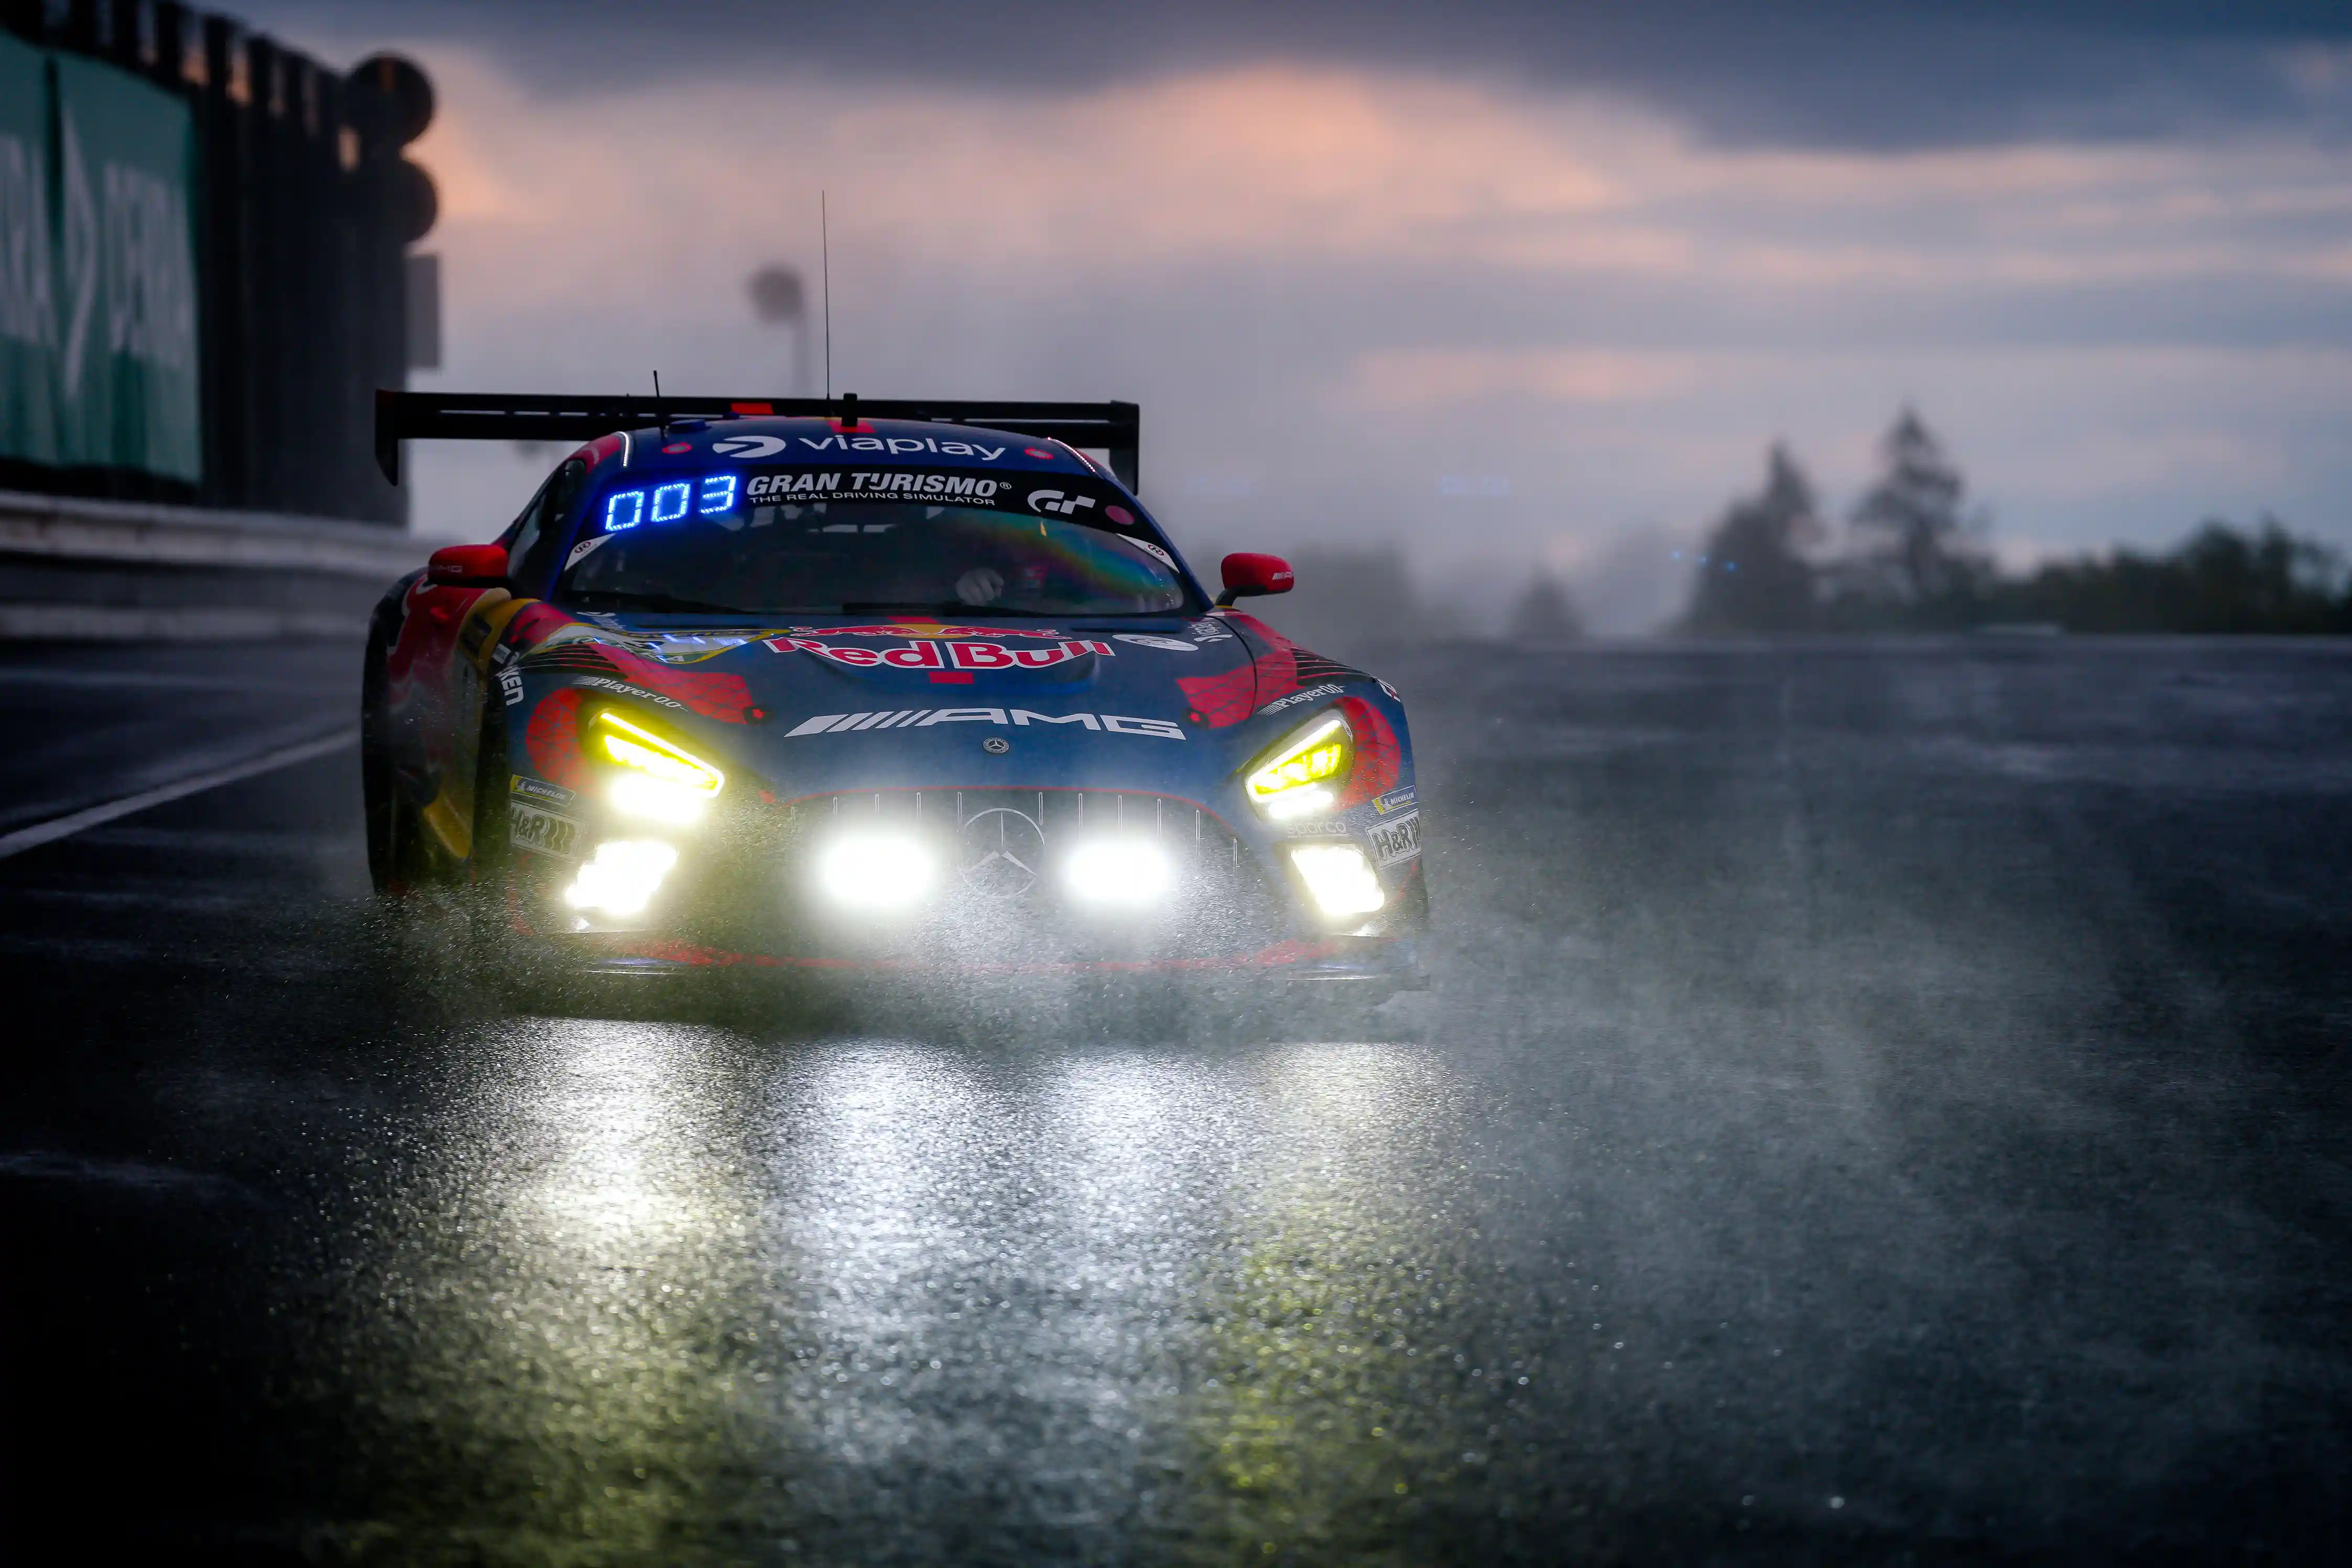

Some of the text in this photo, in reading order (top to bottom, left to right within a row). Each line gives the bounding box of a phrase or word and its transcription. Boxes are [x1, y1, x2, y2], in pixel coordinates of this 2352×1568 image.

[798, 434, 1006, 461] viaplay
[747, 473, 841, 495] GRAN
[606, 475, 736, 531] 003
[749, 495, 782, 504] THE
[787, 493, 823, 501] REAL
[903, 493, 995, 506] SIMULATOR
[763, 638, 944, 669] Red
[945, 639, 1115, 669] Bull
[915, 709, 1186, 740] AMG
[526, 785, 567, 800] MICHELIN
[1390, 792, 1414, 805] MICHELIN
[1373, 816, 1418, 861] H&R
